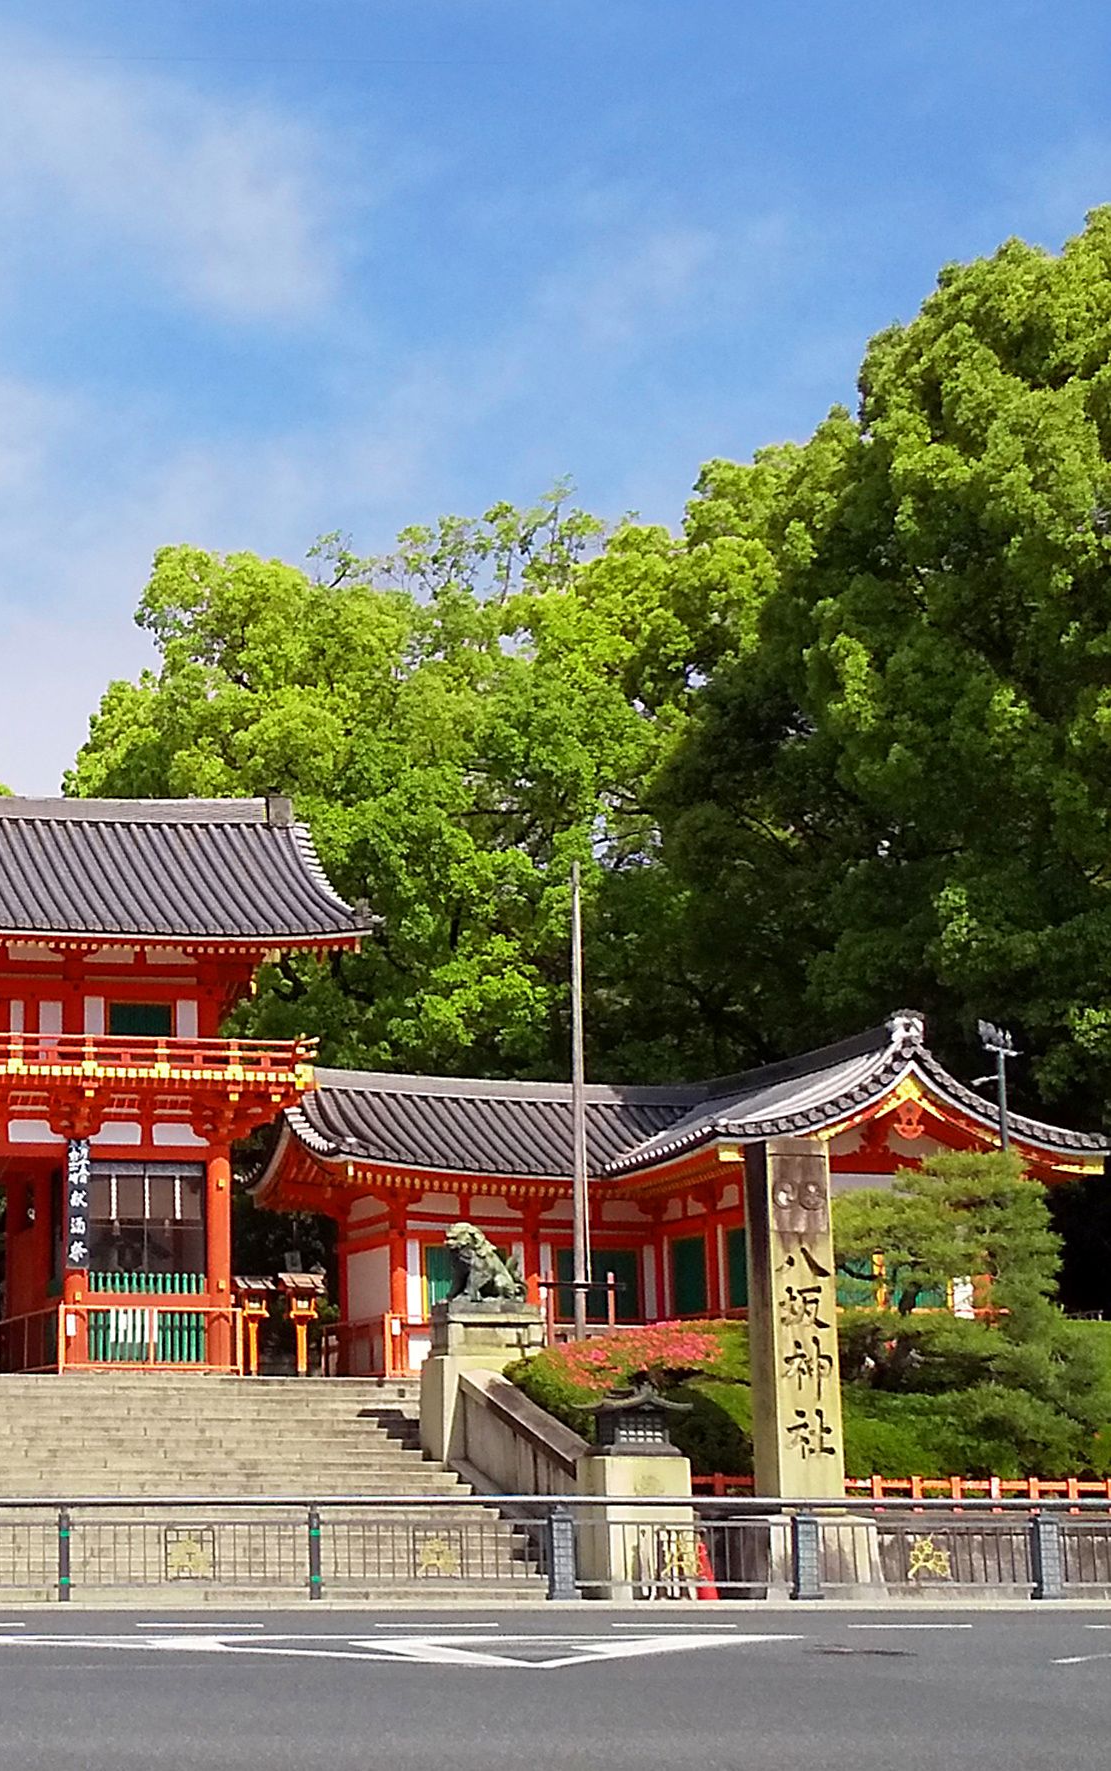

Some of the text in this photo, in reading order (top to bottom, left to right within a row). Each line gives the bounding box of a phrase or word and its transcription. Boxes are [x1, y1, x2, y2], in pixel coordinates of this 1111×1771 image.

[68, 1190, 89, 1262] 献酒祭
[774, 1246, 837, 1460] 八坂神社
